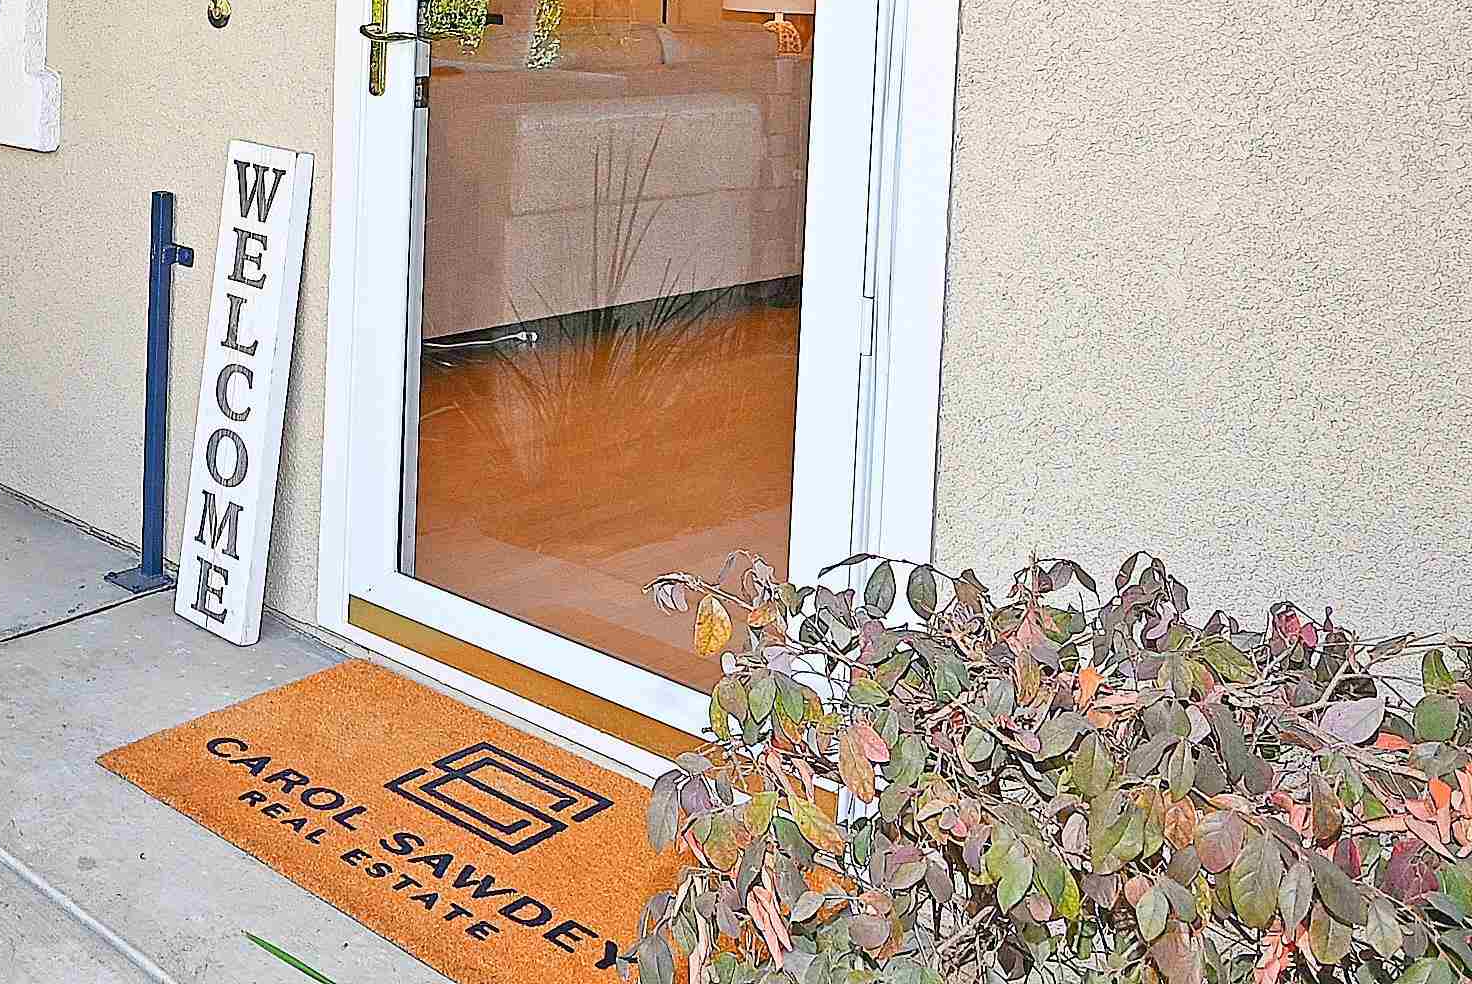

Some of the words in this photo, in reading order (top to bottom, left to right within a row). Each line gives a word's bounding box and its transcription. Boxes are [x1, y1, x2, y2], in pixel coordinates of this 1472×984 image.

[191, 159, 286, 624] WELCOME
[206, 736, 370, 832] CAROL
[379, 831, 639, 970] SAWDEY
[238, 790, 329, 845] REAL
[340, 849, 503, 942] ESTATE
